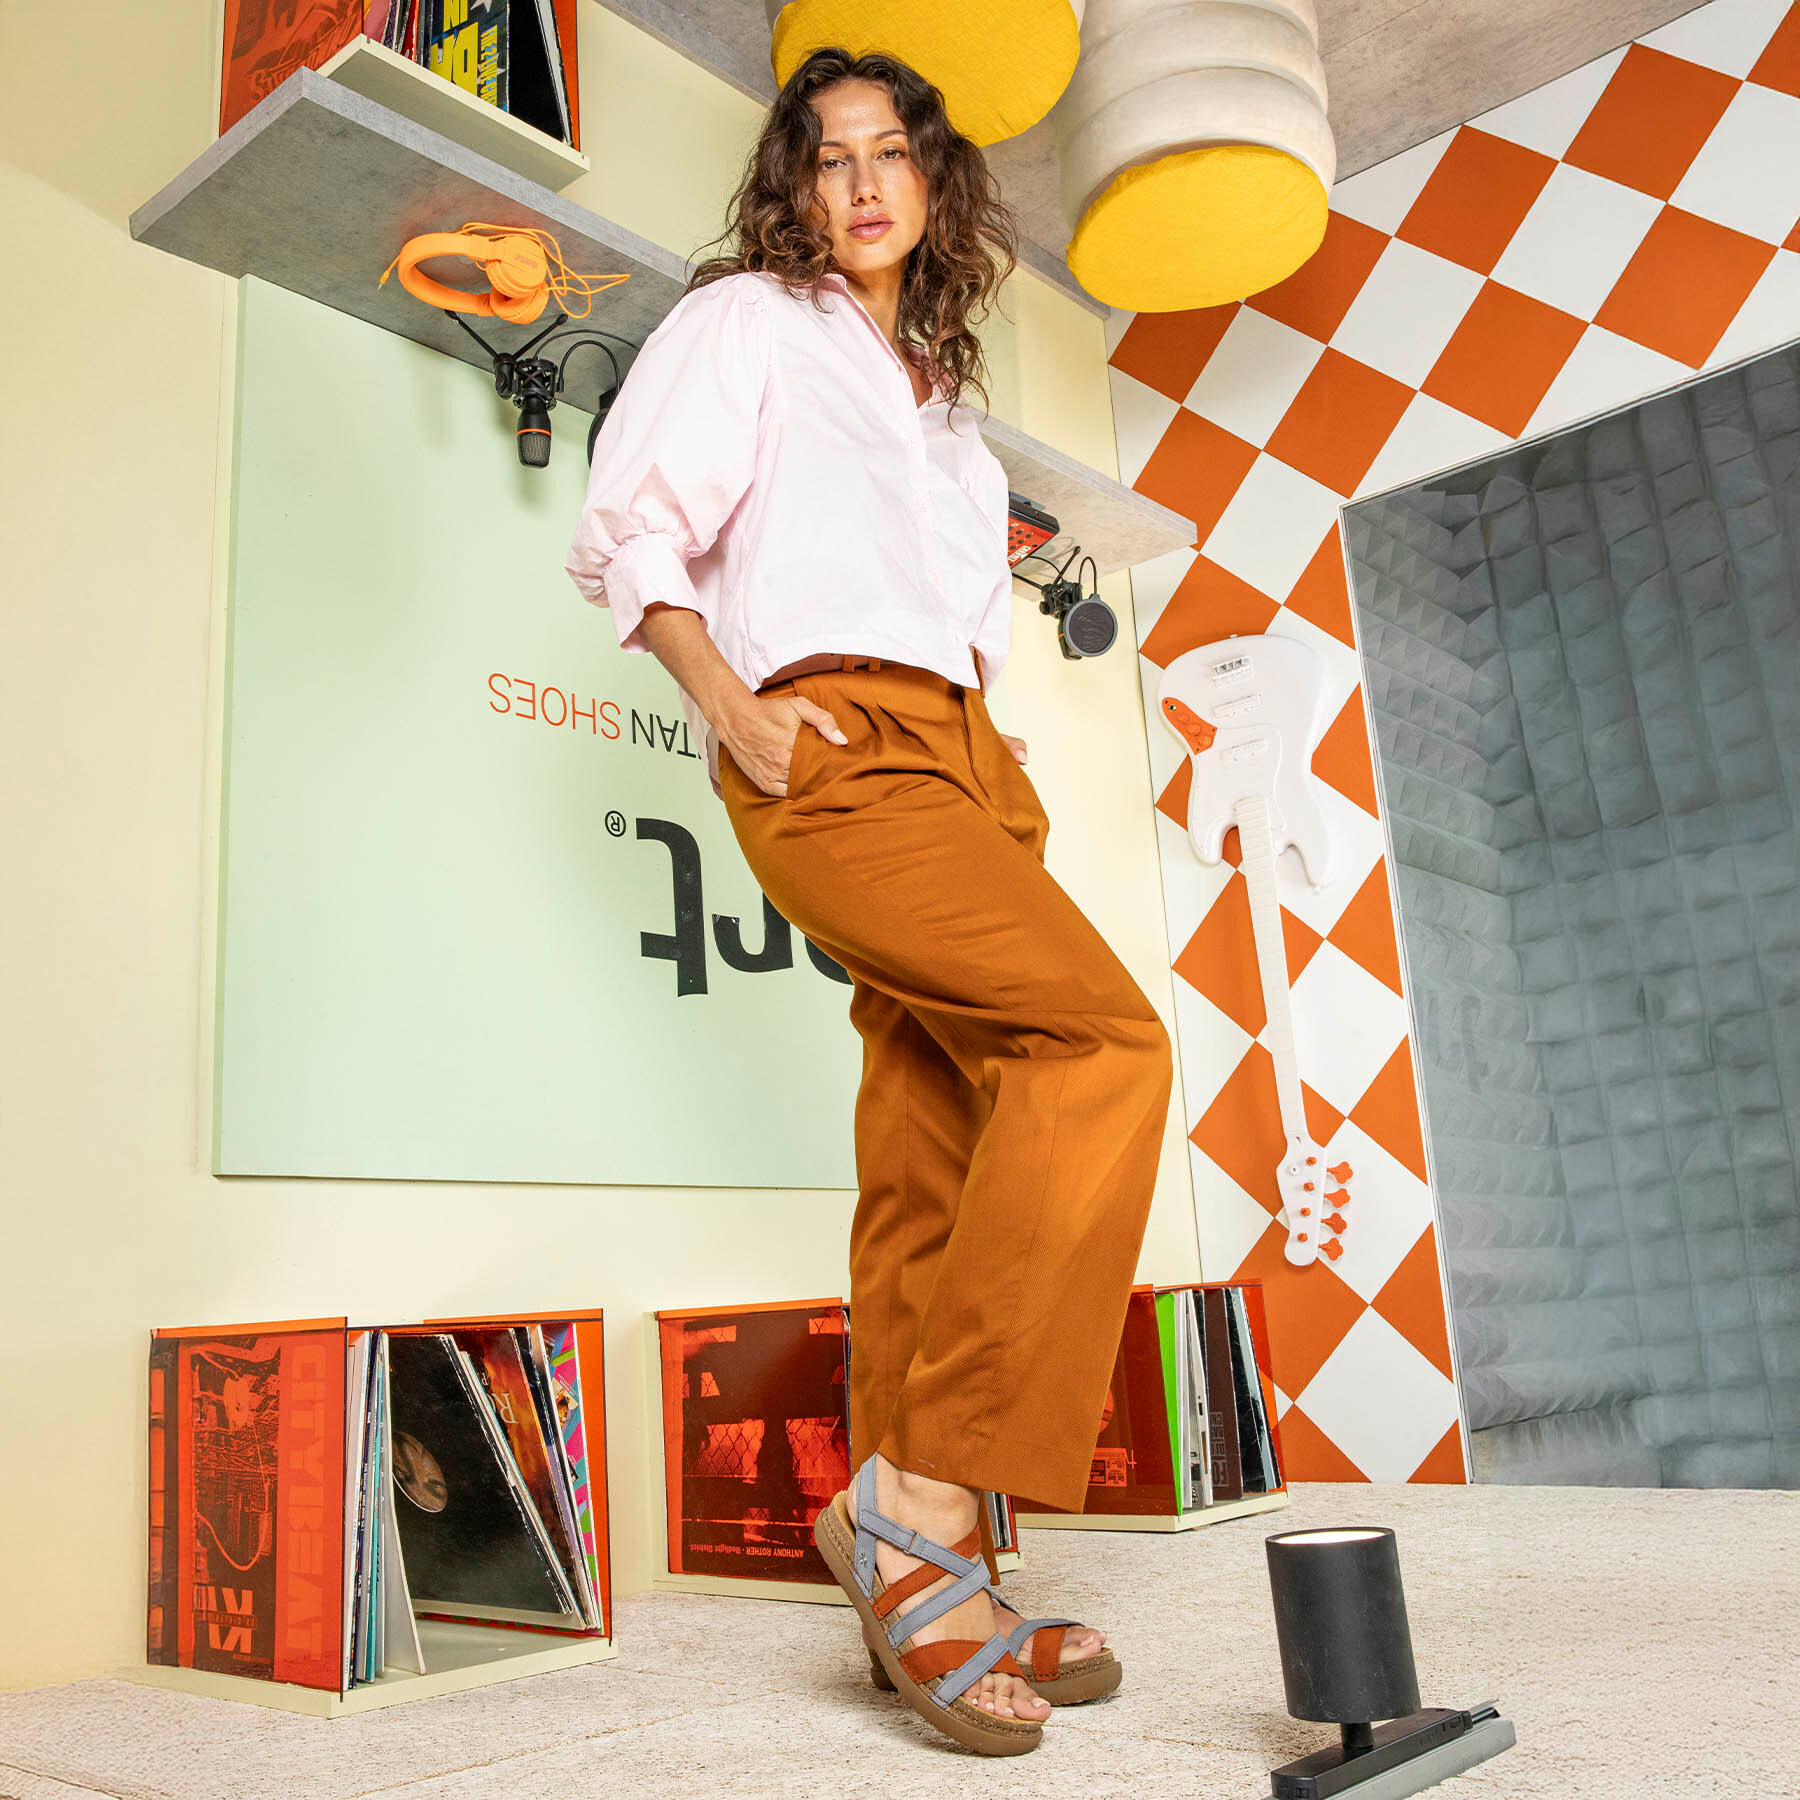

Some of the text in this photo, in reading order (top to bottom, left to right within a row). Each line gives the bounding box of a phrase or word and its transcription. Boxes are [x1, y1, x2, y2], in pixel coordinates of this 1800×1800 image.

[487, 673, 702, 760] TAN SHOES
[635, 817, 854, 997] rt
[287, 1344, 327, 1661] CITYBEAT
[746, 1546, 772, 1556] ROTHER
[773, 1548, 805, 1558] ANTHONY
